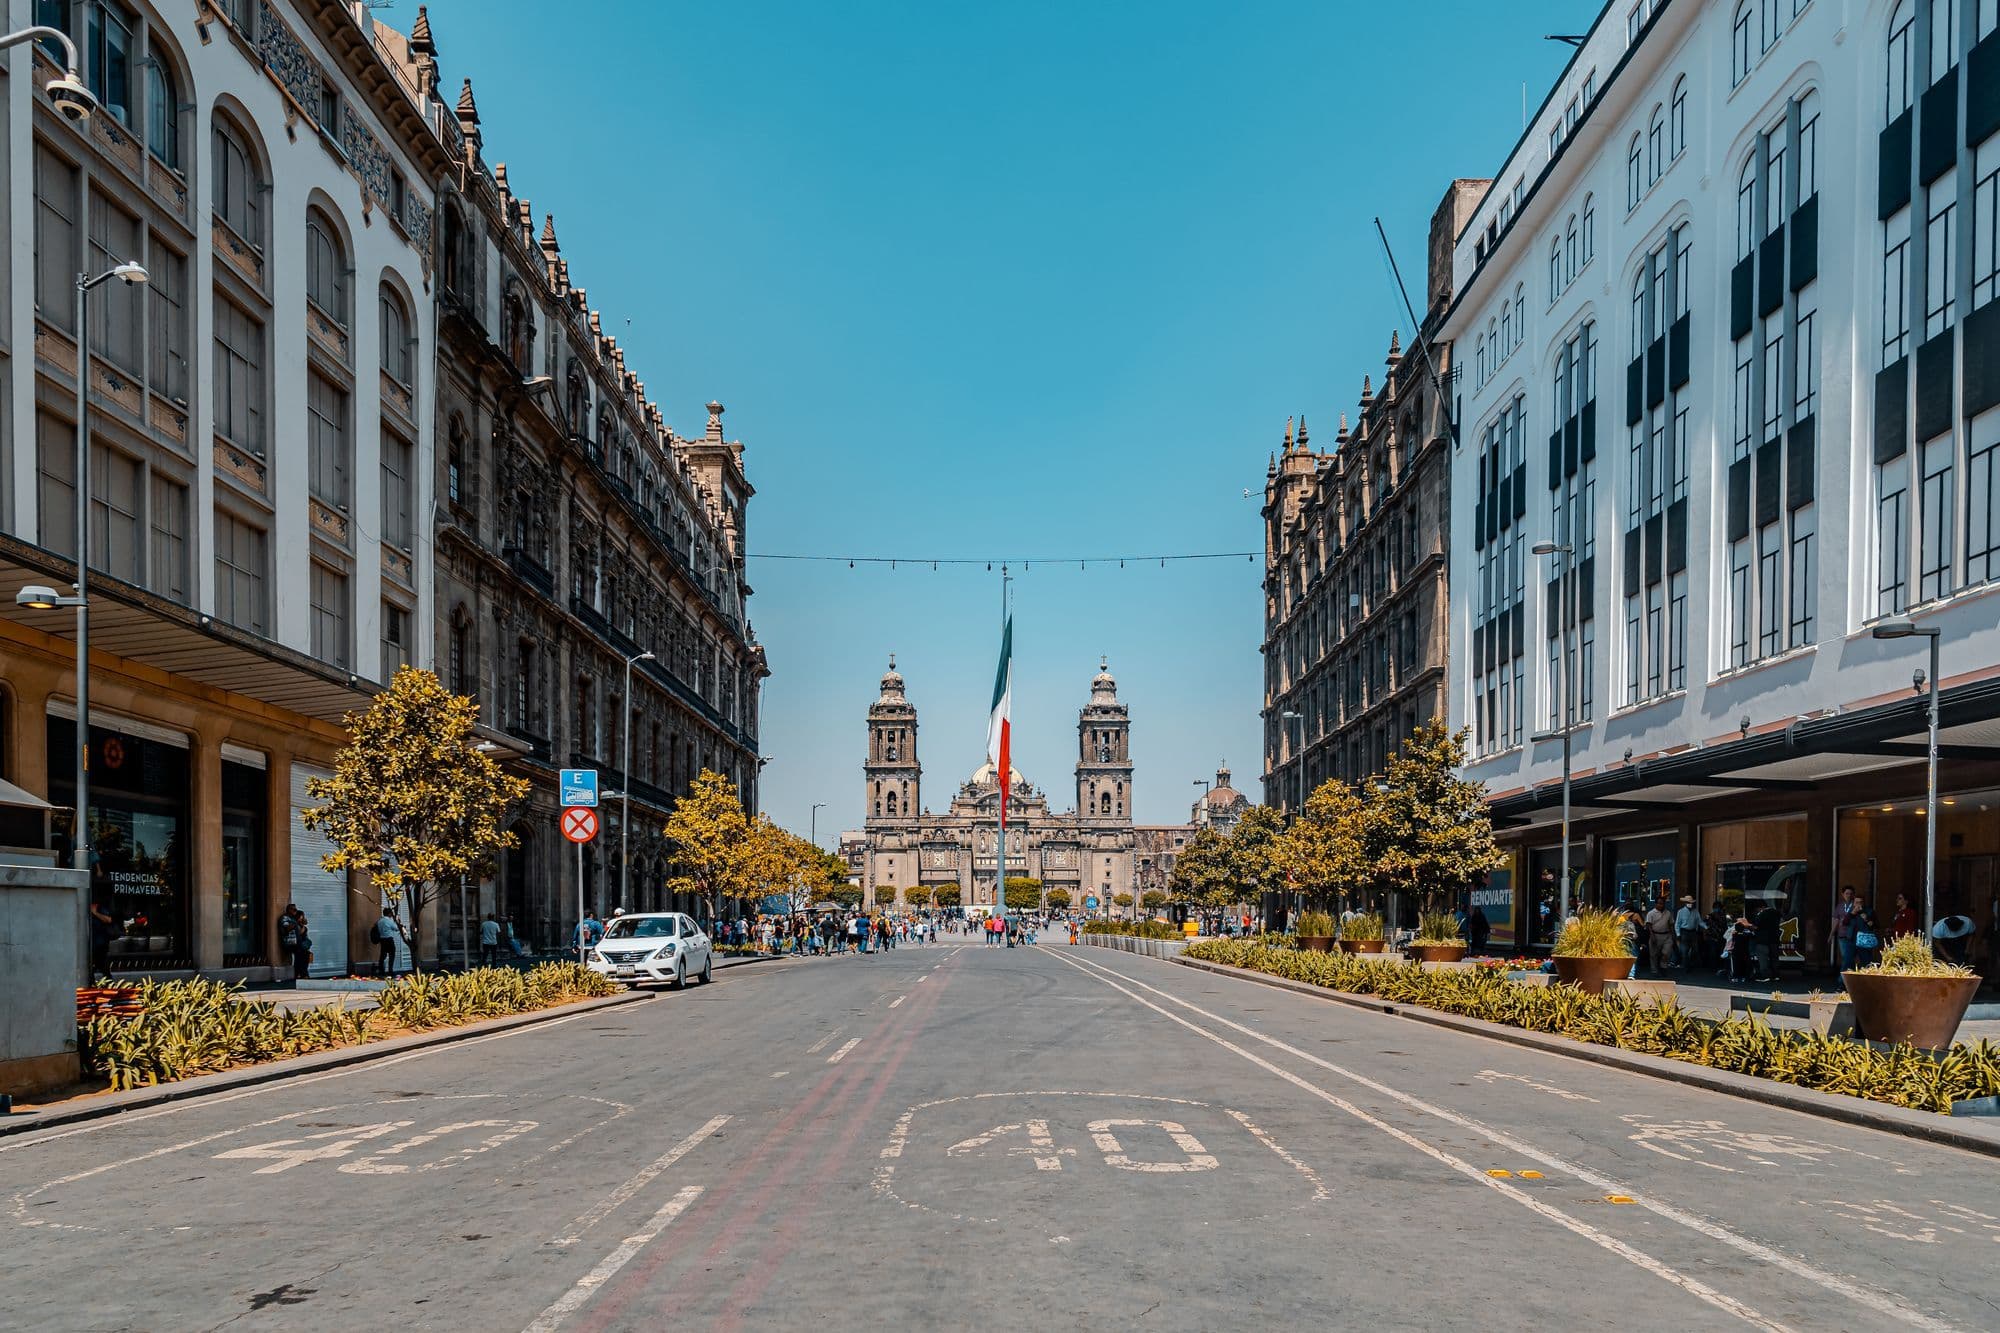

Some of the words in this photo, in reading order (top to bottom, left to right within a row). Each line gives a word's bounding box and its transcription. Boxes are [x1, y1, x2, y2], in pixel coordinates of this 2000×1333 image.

[573, 772, 583, 784] E
[109, 871, 160, 883] TENDENCIAS
[114, 884, 161, 895] PRIMAVERA
[1470, 889, 1514, 905] RENOVARTE
[211, 1120, 540, 1174] 40
[947, 1119, 1220, 1172] 40
